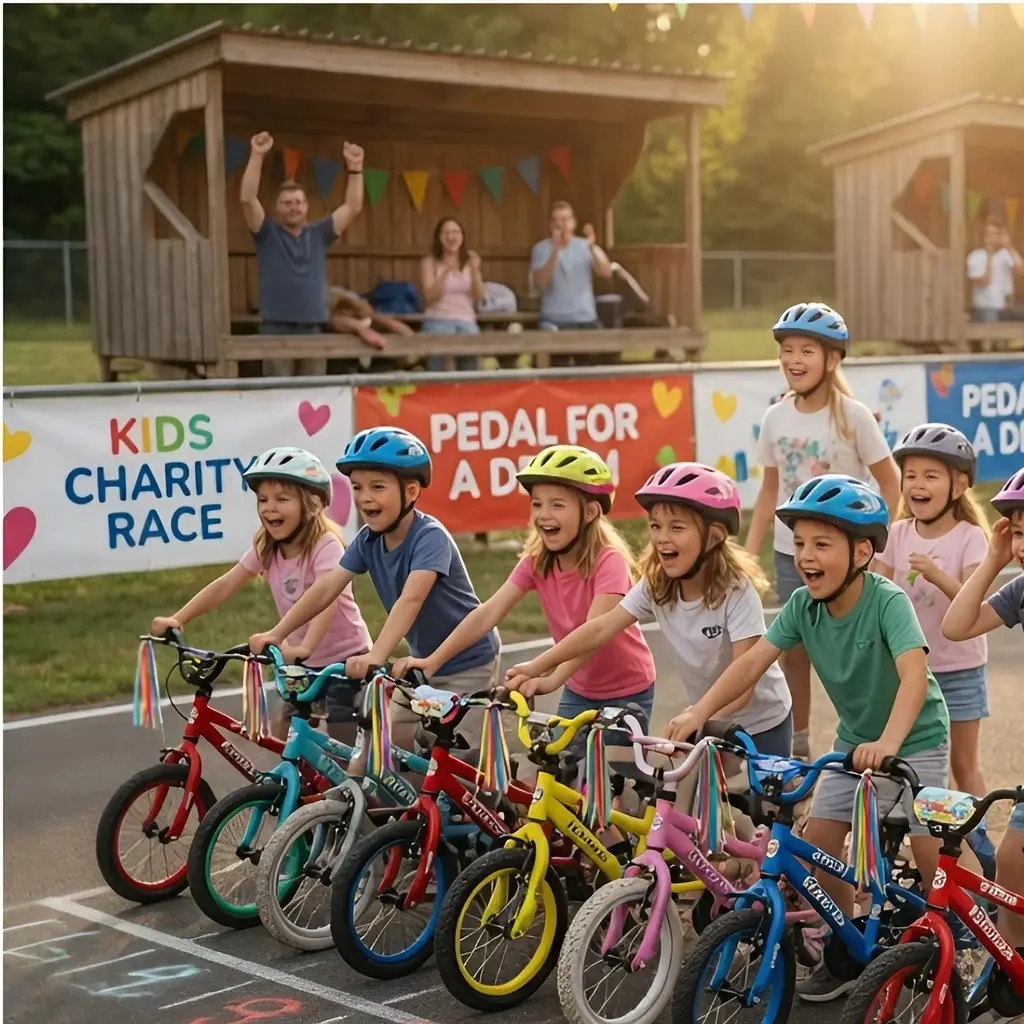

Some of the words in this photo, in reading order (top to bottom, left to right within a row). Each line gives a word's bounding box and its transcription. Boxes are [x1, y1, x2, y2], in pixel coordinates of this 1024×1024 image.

[109, 413, 214, 456] KIDS
[430, 408, 558, 453] PEDAL
[566, 403, 640, 445] FOR
[972, 423, 995, 456] A
[64, 455, 259, 505] CHARITY
[449, 459, 481, 500] A
[107, 503, 224, 549] RACE
